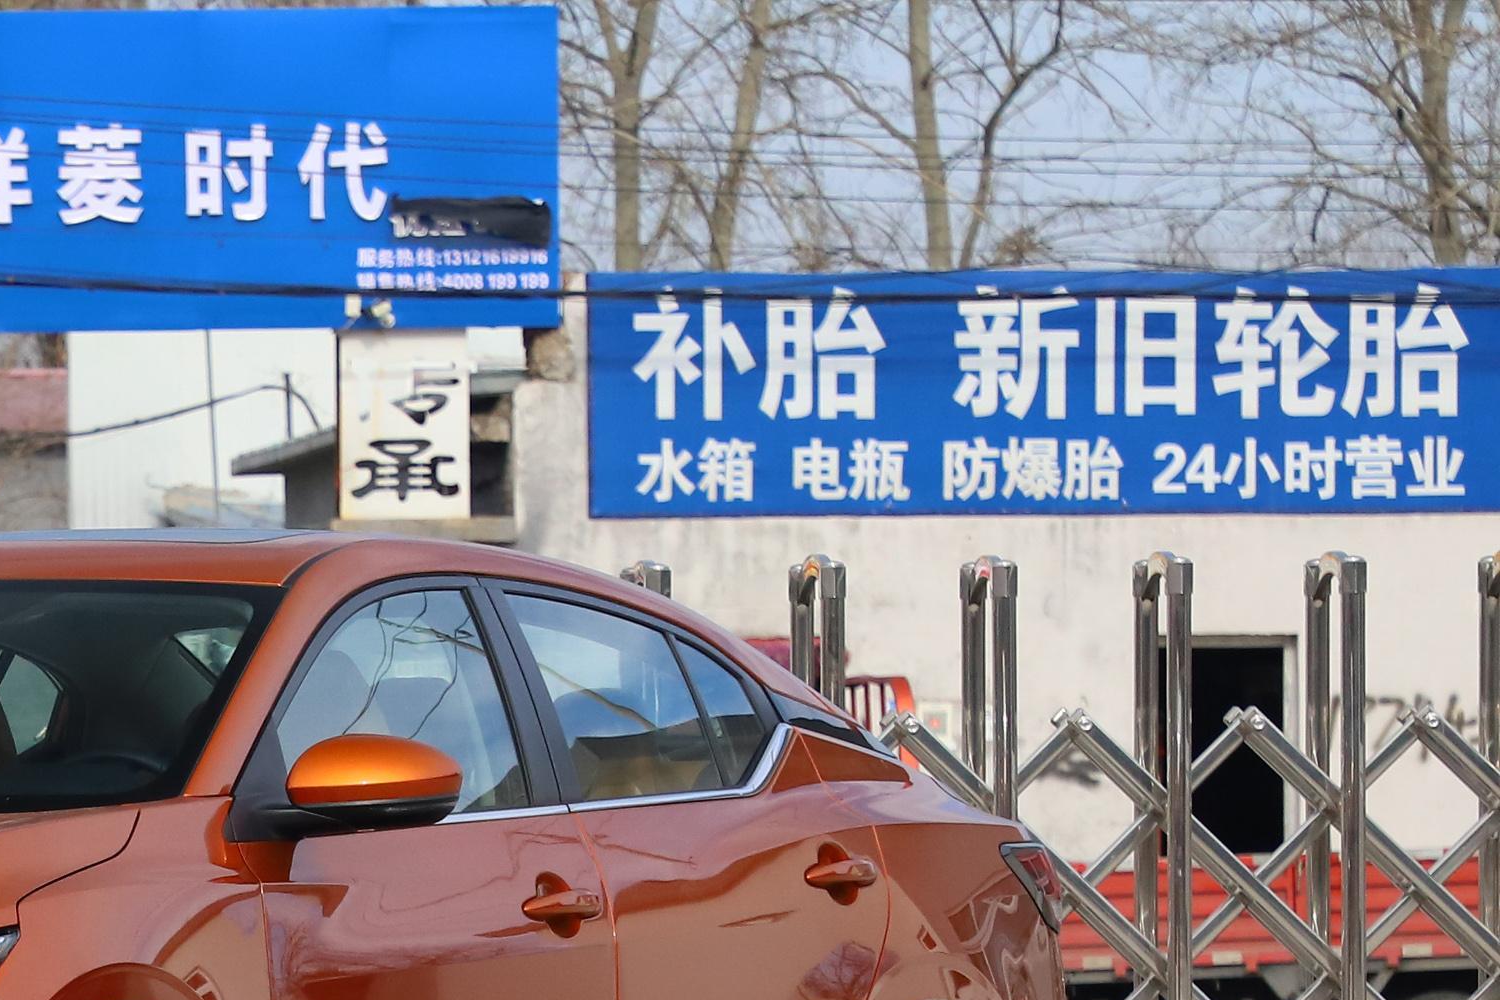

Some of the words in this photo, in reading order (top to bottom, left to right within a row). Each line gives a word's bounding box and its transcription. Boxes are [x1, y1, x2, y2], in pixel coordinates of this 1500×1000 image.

[632, 285, 887, 421] 补胎
[952, 285, 1470, 420] 新旧轮胎
[636, 437, 756, 502] 水箱
[792, 437, 910, 501] 电瓶
[942, 436, 1126, 501] 防爆胎
[1152, 435, 1466, 500] 24小时营业
